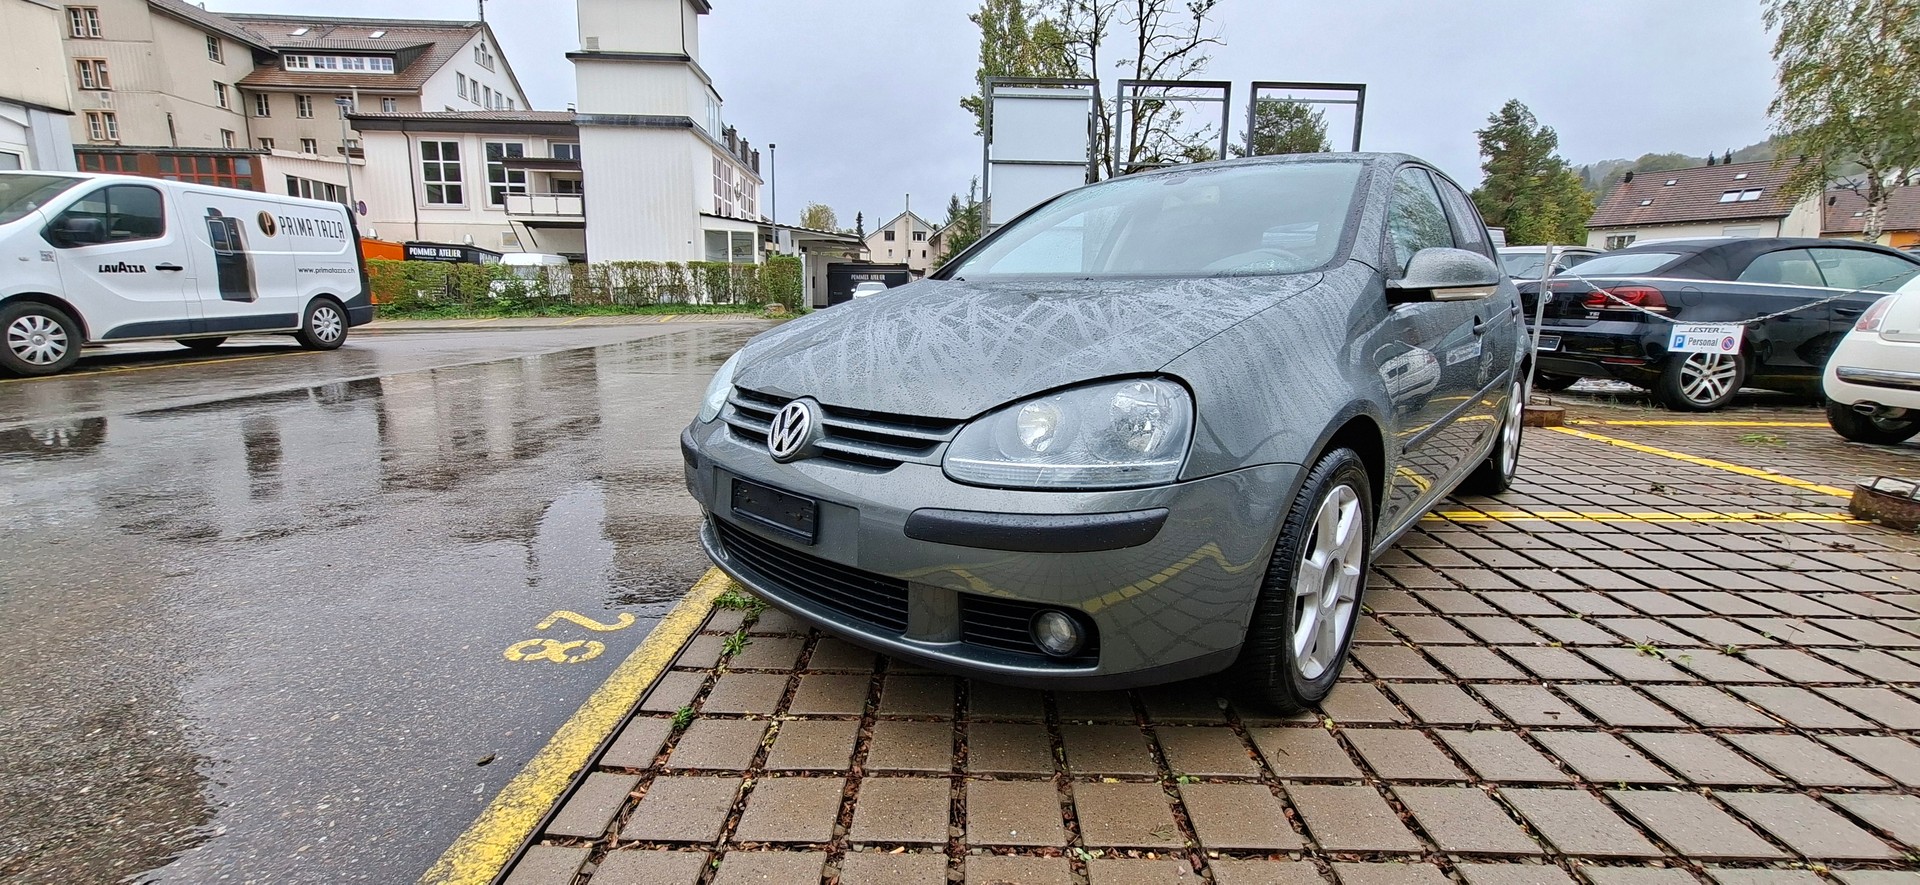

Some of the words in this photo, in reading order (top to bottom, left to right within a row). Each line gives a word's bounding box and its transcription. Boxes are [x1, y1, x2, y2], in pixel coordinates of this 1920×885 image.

[278, 215, 315, 237] PRIMA
[314, 219, 345, 239] TAZZA
[409, 247, 437, 256] POMMES
[438, 249, 462, 258] ATELIER
[98, 261, 147, 273] LAVAZZA
[298, 266, 356, 274] www.primatazza.ch
[1687, 337, 1719, 347] Personal
[503, 610, 636, 664] 28
